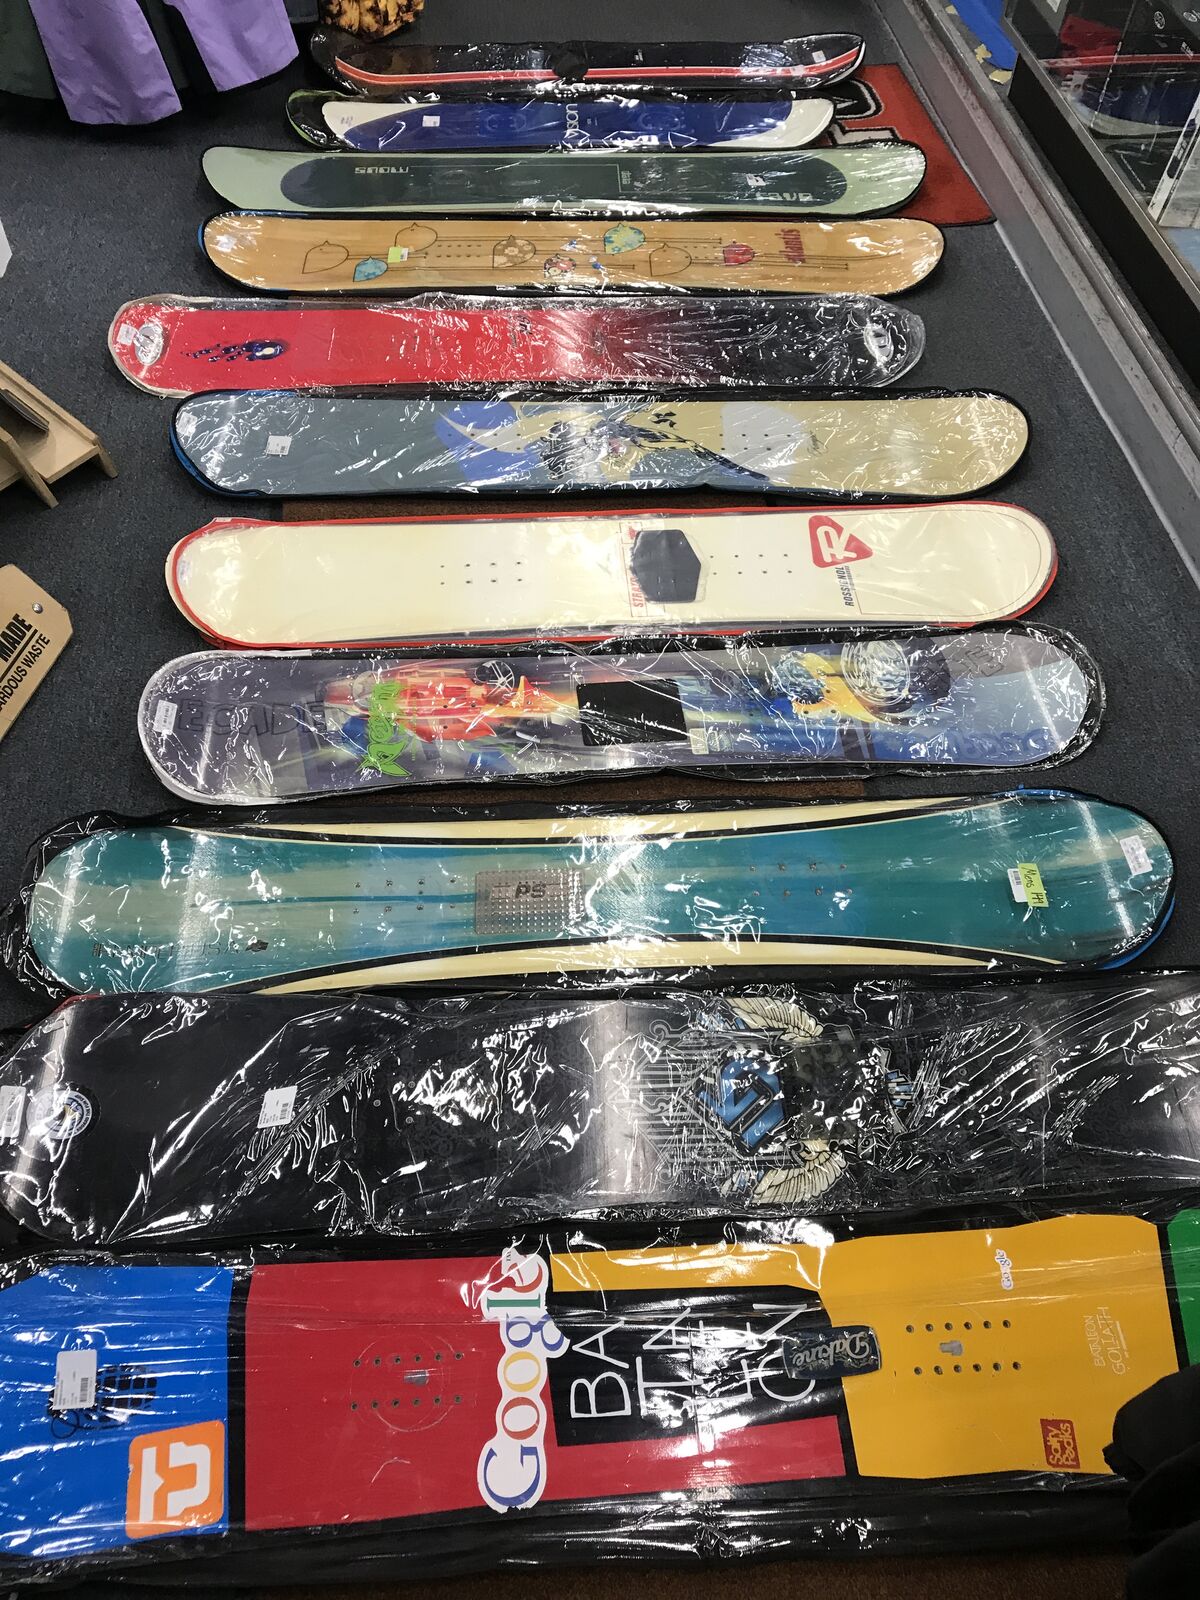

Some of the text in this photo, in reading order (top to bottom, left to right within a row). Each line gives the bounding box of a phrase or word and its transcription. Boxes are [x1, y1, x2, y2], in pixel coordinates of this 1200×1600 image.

[834, 566, 855, 607] ROSSIGNOL
[24, 633, 51, 669] WASTE
[792, 1331, 870, 1366] Dakine
[484, 1258, 564, 1507] Google
[1047, 1426, 1062, 1464] Salty
[1060, 1423, 1076, 1465] Peaks
